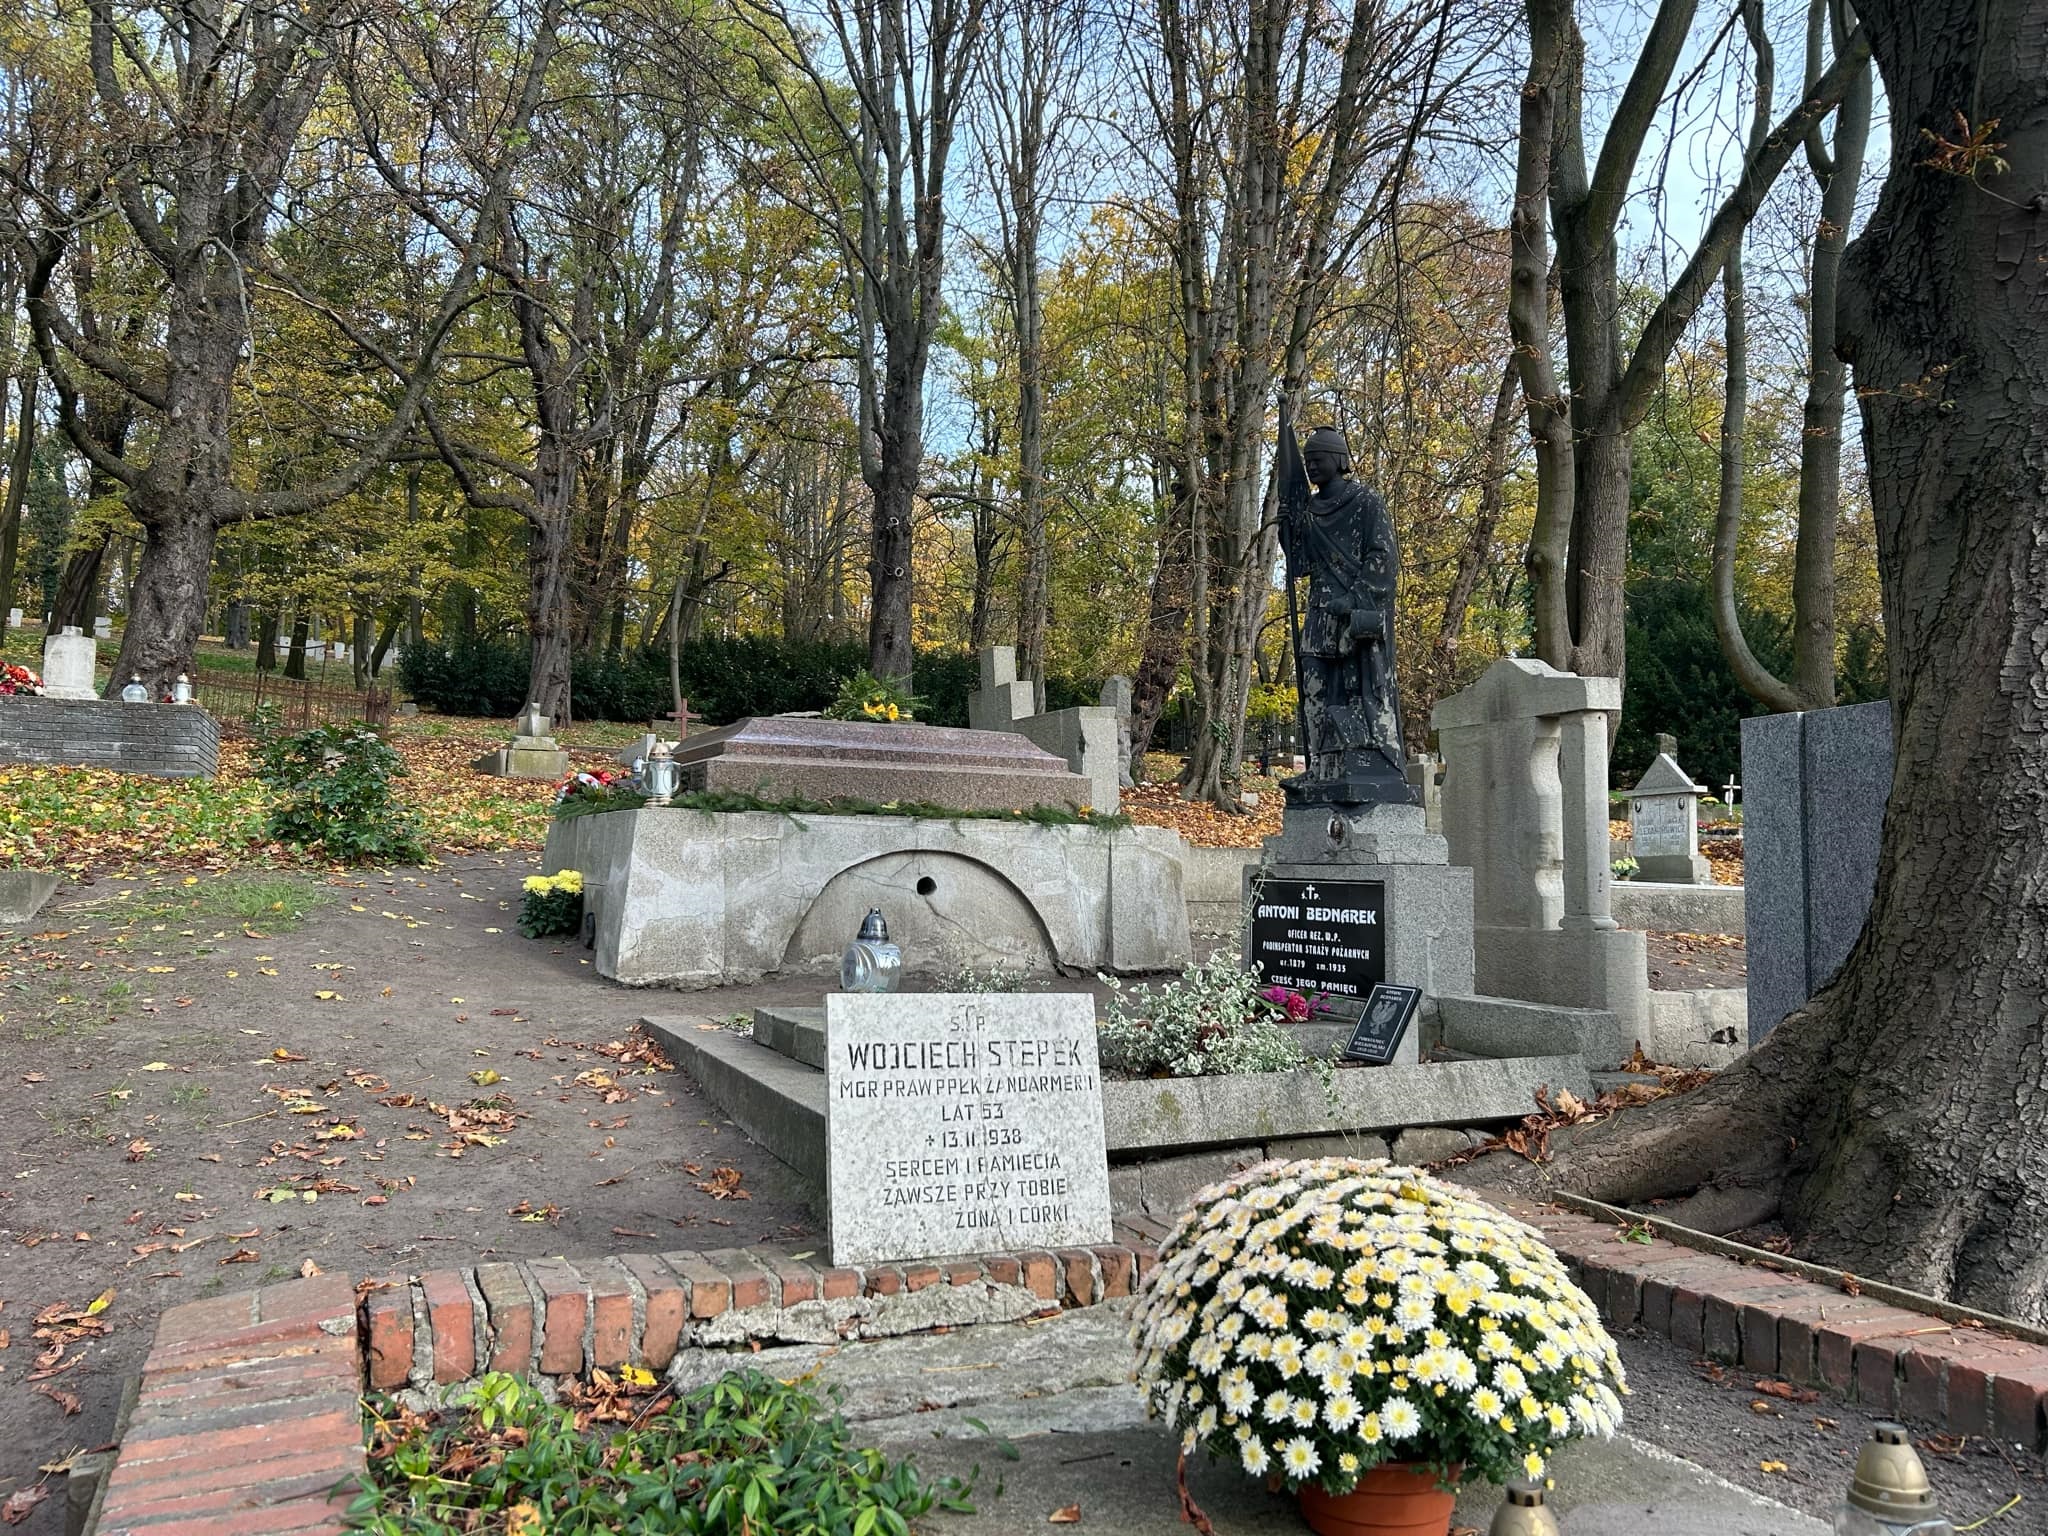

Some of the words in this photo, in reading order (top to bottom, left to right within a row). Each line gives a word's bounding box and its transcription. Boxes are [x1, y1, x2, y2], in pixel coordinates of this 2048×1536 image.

[1258, 905, 1299, 920] ANTONI
[1306, 907, 1377, 925] BEDNAREK
[1287, 929, 1308, 939] OFICER
[1305, 943, 1329, 956] STRAŻY
[1331, 945, 1370, 960] POŻARNYCH
[1295, 977, 1317, 988] JEGO
[1321, 981, 1357, 994] PAMIĘCI
[848, 1041, 976, 1071] WOJCIECH
[840, 1080, 878, 1099] MGR
[884, 1079, 932, 1097] PRAW
[936, 1077, 981, 1096] PPŁK
[942, 1104, 974, 1122] LAT
[982, 1102, 1004, 1120] 53
[886, 1158, 959, 1178] SERCEM
[966, 1157, 970, 1174] I
[883, 1184, 957, 1208] ZAWSZE
[964, 1180, 1011, 1201] PRZY
[1017, 1178, 1067, 1198] TOBIE
[955, 1206, 1001, 1229] ŻONA
[1008, 1207, 1013, 1225] I
